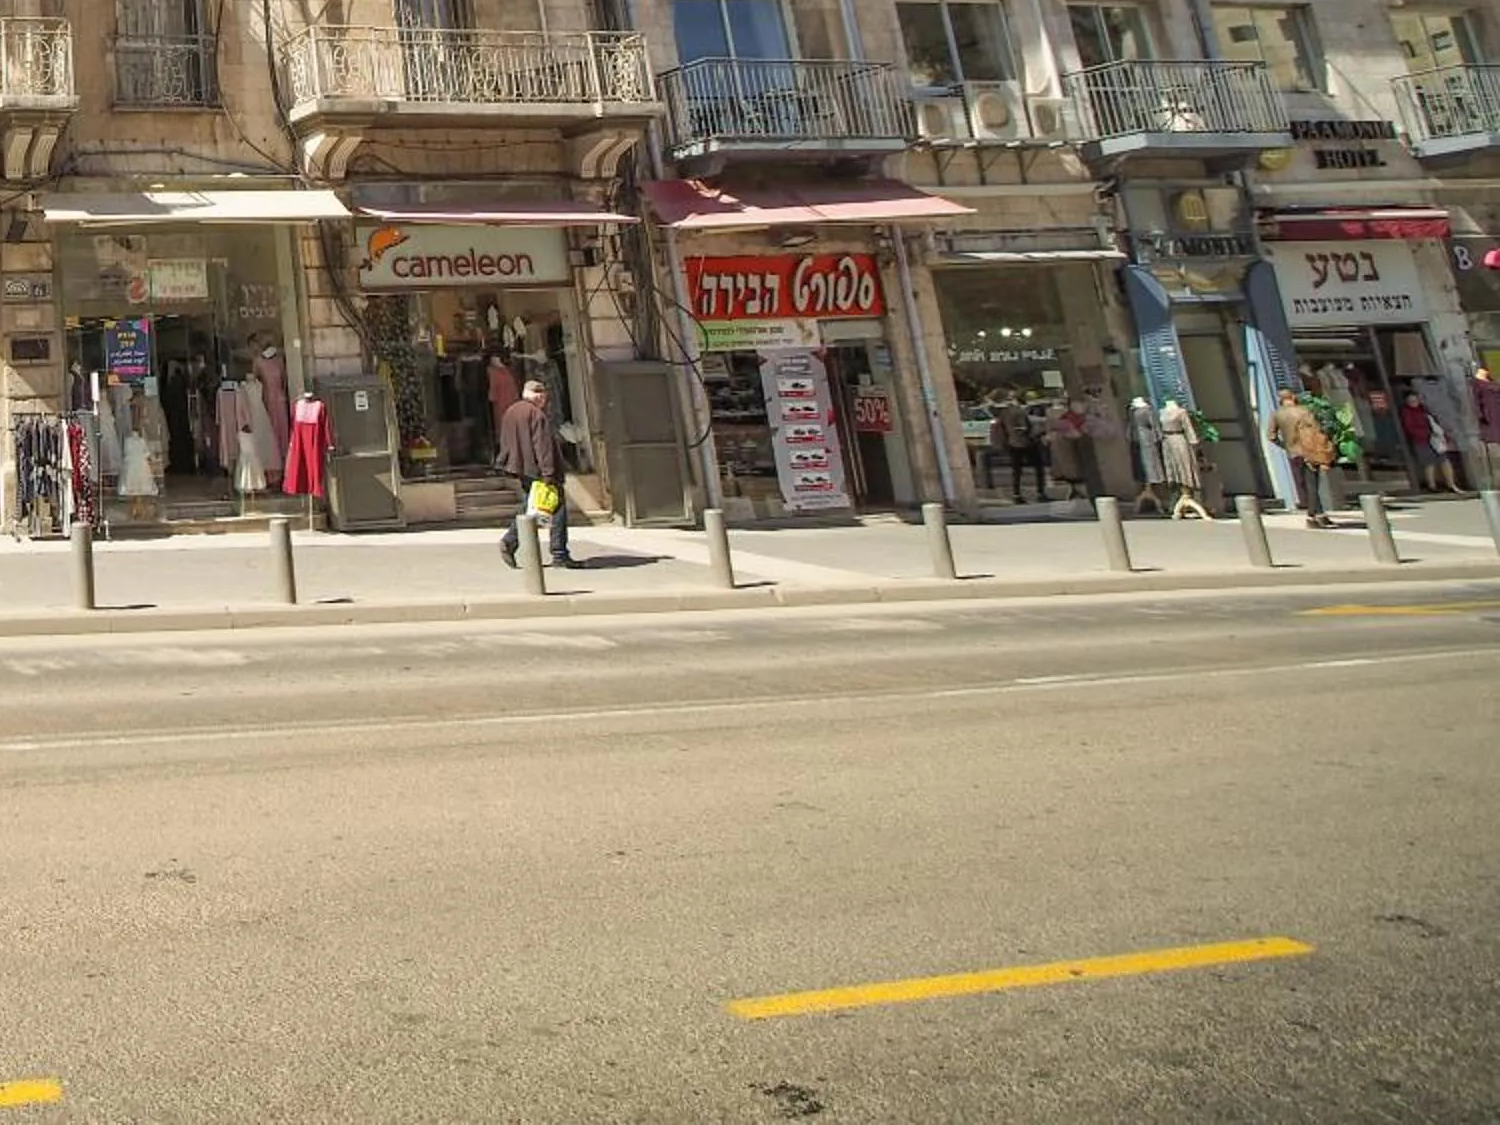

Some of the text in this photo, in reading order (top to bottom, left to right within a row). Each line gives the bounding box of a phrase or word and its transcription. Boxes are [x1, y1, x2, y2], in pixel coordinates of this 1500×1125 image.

[392, 248, 535, 277] cameleon
[702, 256, 875, 315] ספורט הבירה
[853, 397, 889, 424] 50%
